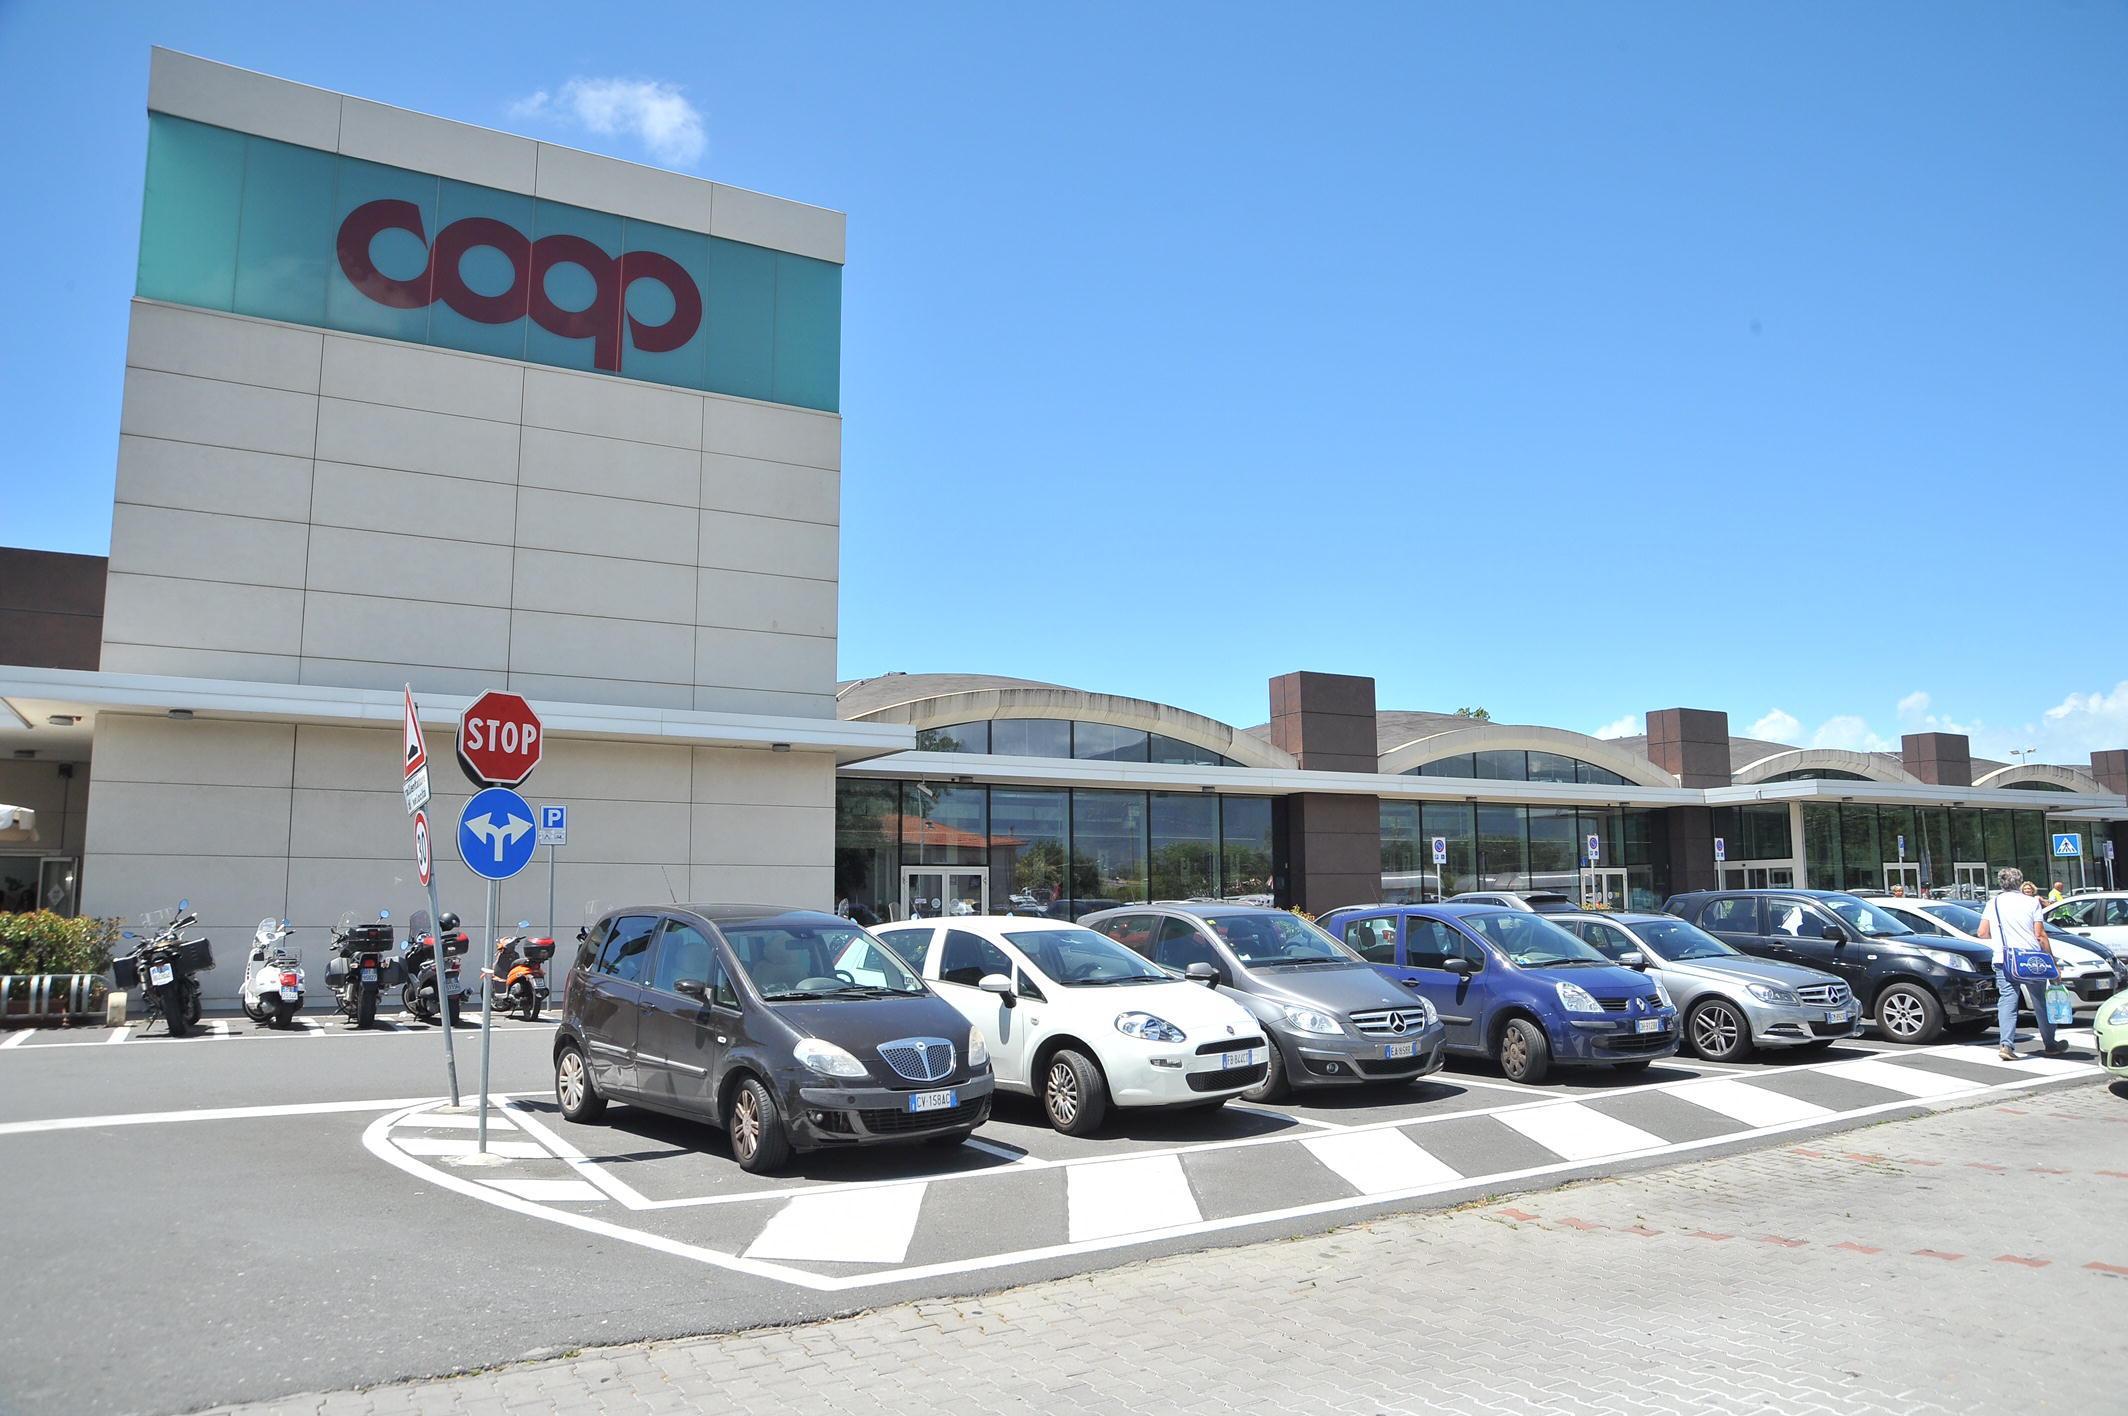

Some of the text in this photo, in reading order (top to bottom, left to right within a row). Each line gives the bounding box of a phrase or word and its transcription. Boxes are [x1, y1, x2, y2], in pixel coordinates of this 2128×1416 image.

[336, 198, 703, 372] coop
[467, 717, 537, 755] STOP
[548, 809, 562, 827] P
[417, 831, 427, 866] 30
[916, 1093, 951, 1108] CV 158AC
